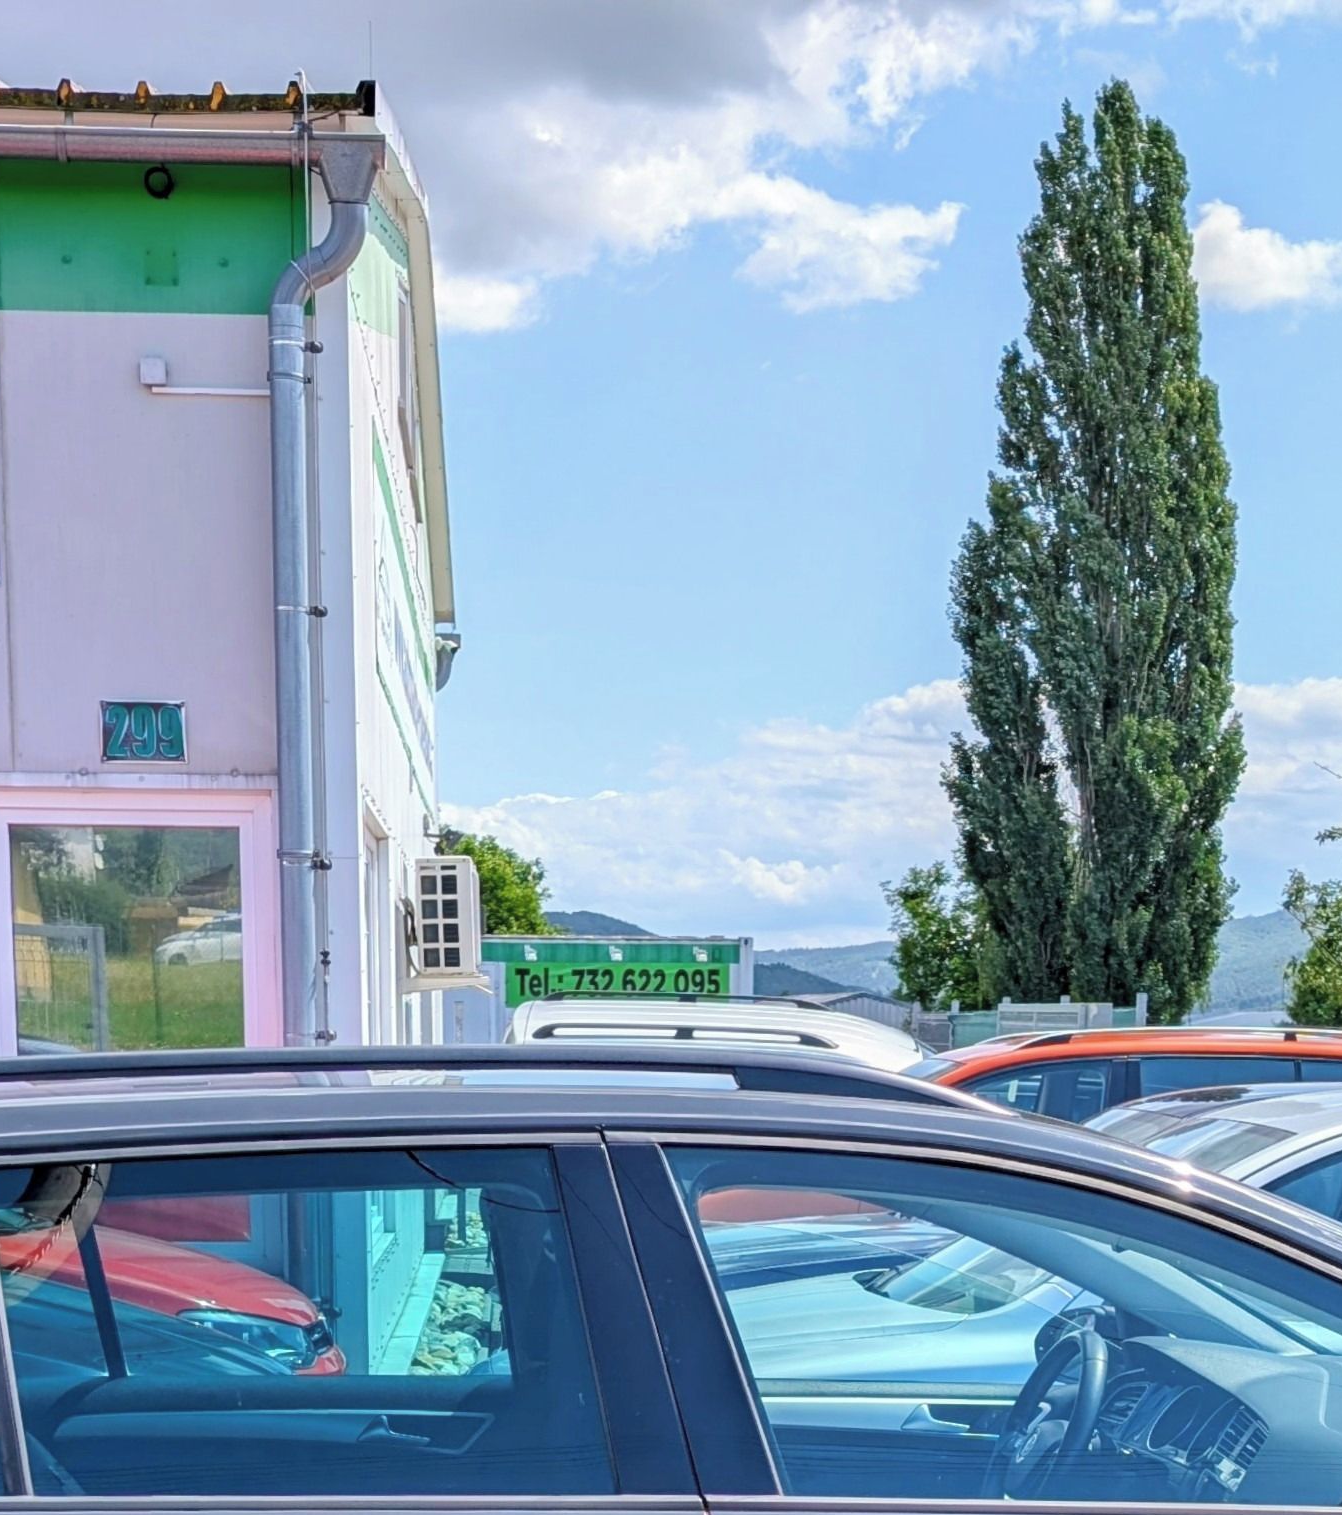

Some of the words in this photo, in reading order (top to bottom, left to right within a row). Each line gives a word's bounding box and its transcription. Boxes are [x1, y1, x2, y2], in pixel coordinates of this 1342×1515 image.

[105, 704, 183, 758] 299
[515, 967, 564, 997] Tel.:
[571, 968, 615, 994] 732
[622, 968, 666, 994] 622
[674, 968, 721, 994] 095
